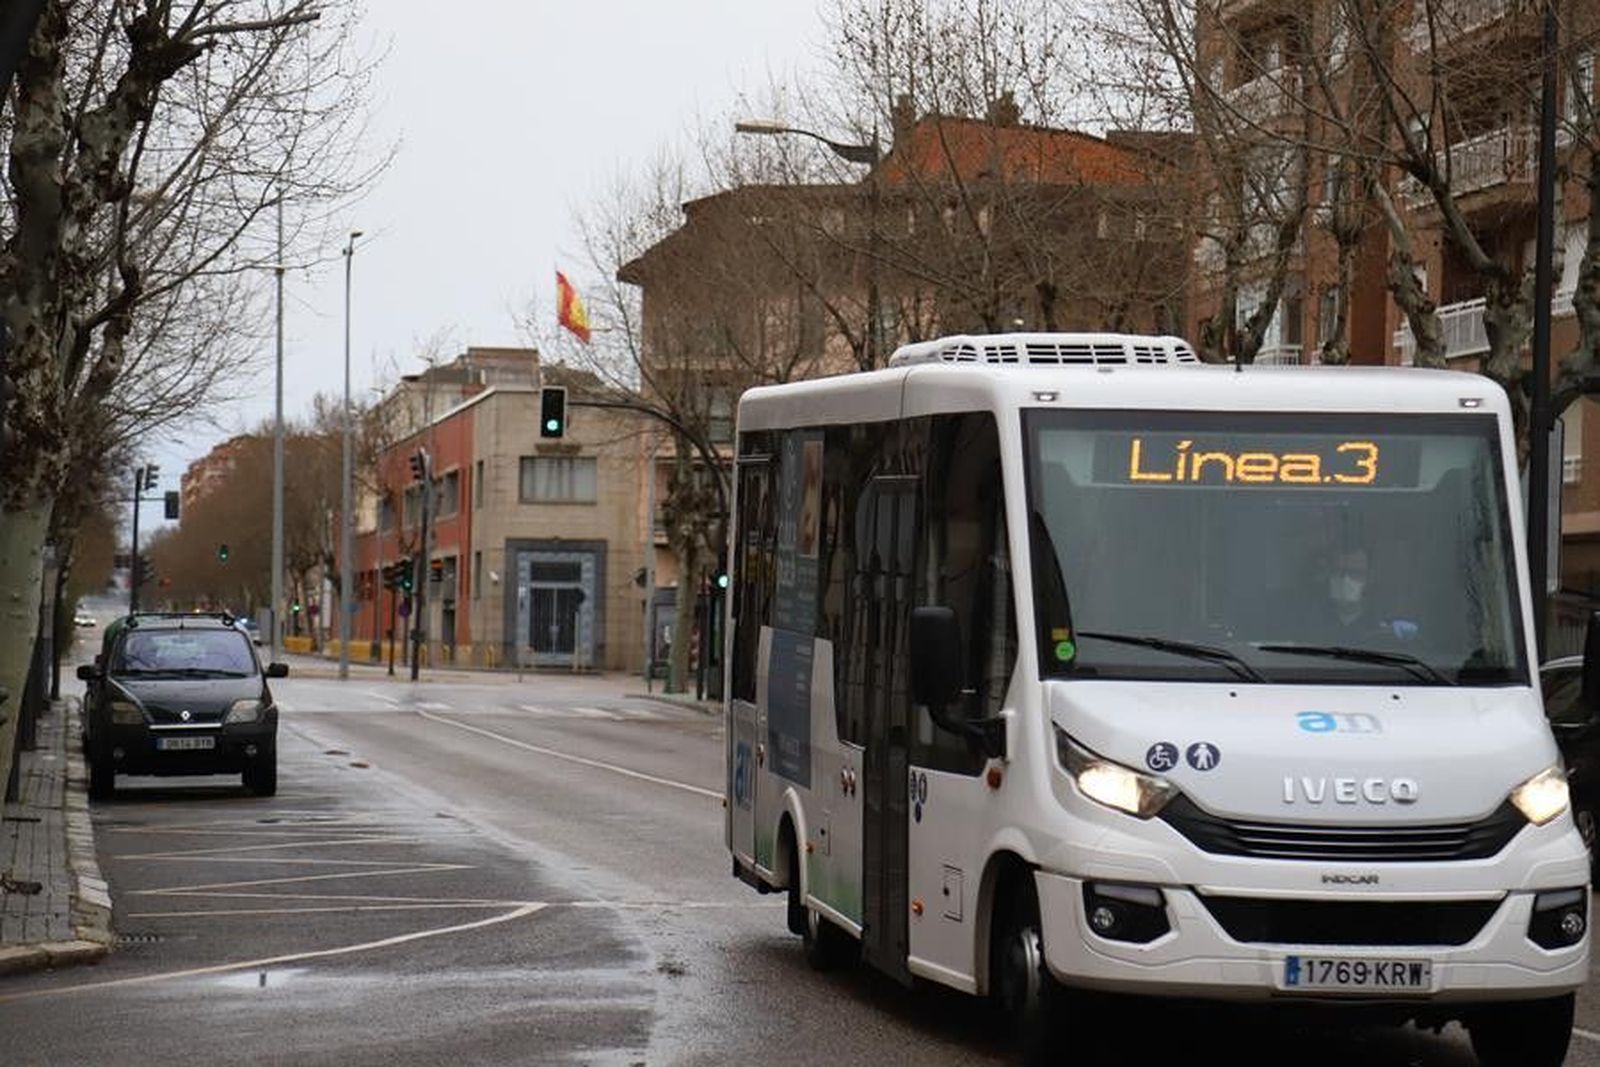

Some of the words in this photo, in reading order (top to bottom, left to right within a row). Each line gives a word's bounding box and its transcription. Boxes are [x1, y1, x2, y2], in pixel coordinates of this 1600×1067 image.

[1129, 439, 1379, 485] Línea.3
[1282, 775, 1418, 804] IVECO
[1306, 960, 1368, 984] 1769
[1375, 962, 1423, 986] KRW
